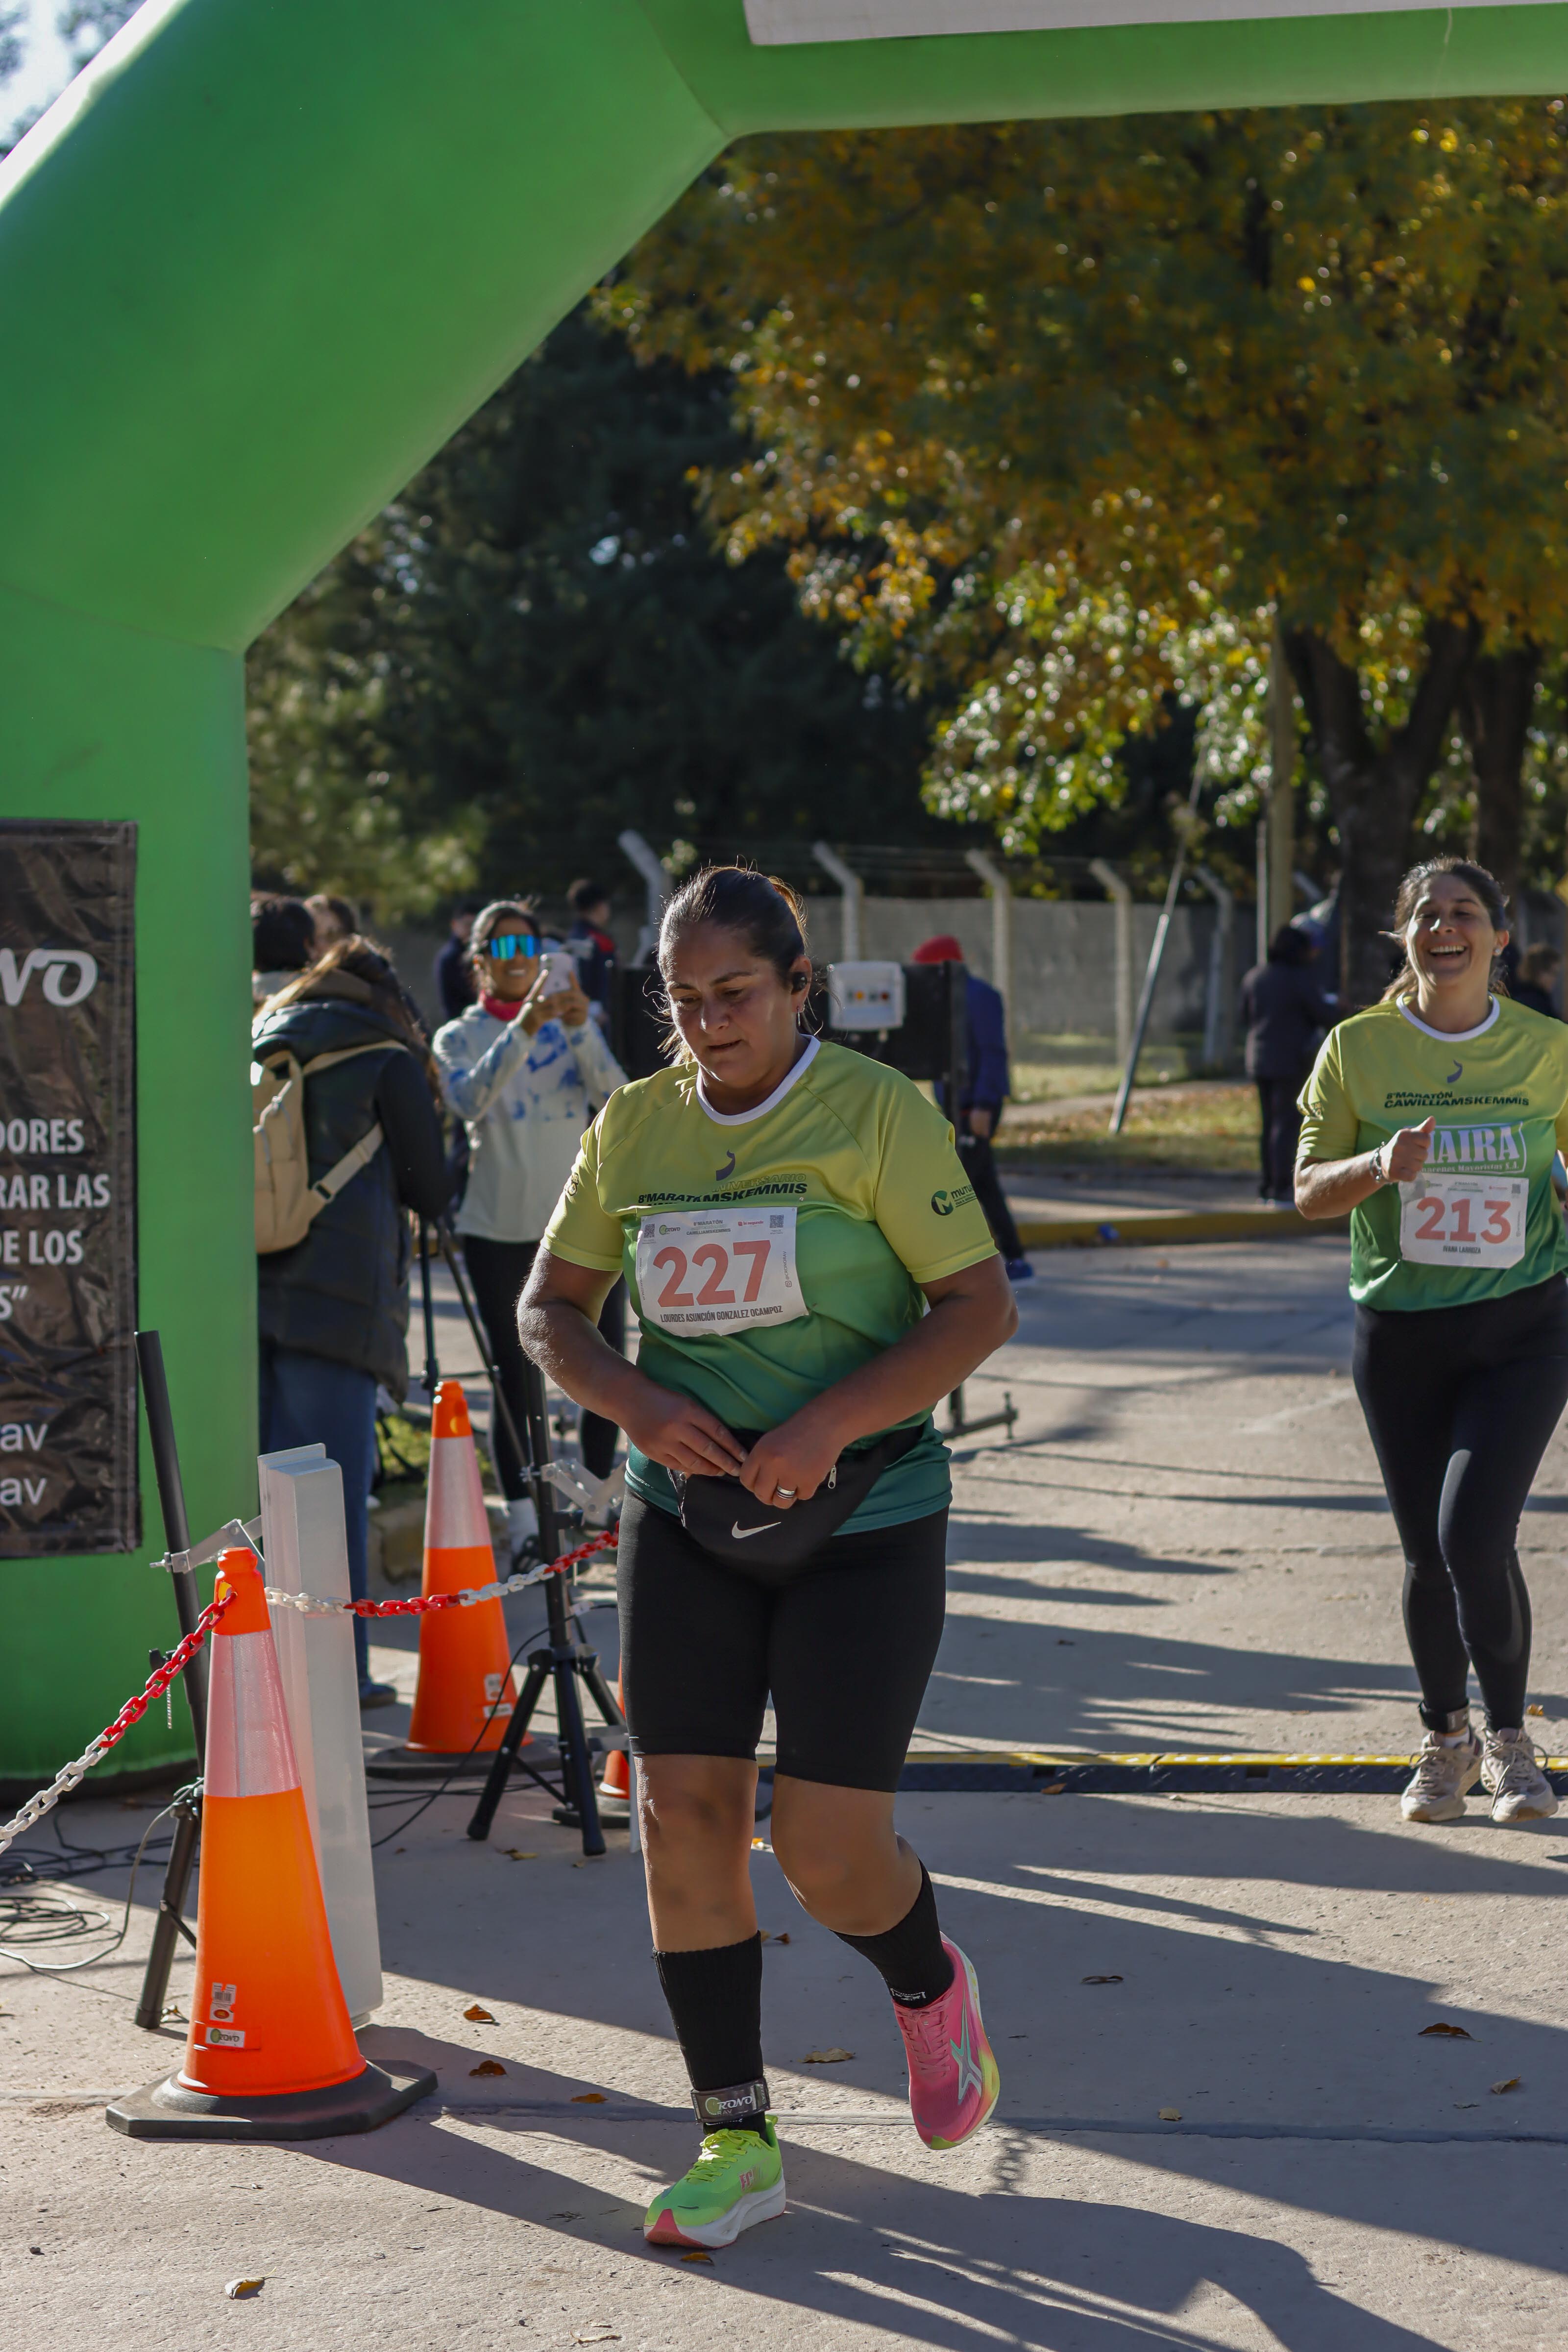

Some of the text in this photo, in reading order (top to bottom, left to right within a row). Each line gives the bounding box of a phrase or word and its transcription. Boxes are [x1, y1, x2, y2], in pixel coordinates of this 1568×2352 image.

[1384, 1096, 1529, 1108] CAWILLIAMSKEMMIS
[0, 1118, 85, 1154] ORES
[57, 1173, 111, 1209] LAS
[712, 1173, 807, 1192] NIVERSARIO
[1415, 1197, 1511, 1244] 213
[29, 1229, 83, 1265] LOS
[653, 1240, 771, 1307] 227
[660, 1305, 784, 1323] LOURDES ASUNCIÓN GONZALEZ OCAMPOZ
[0, 1423, 48, 1452] av
